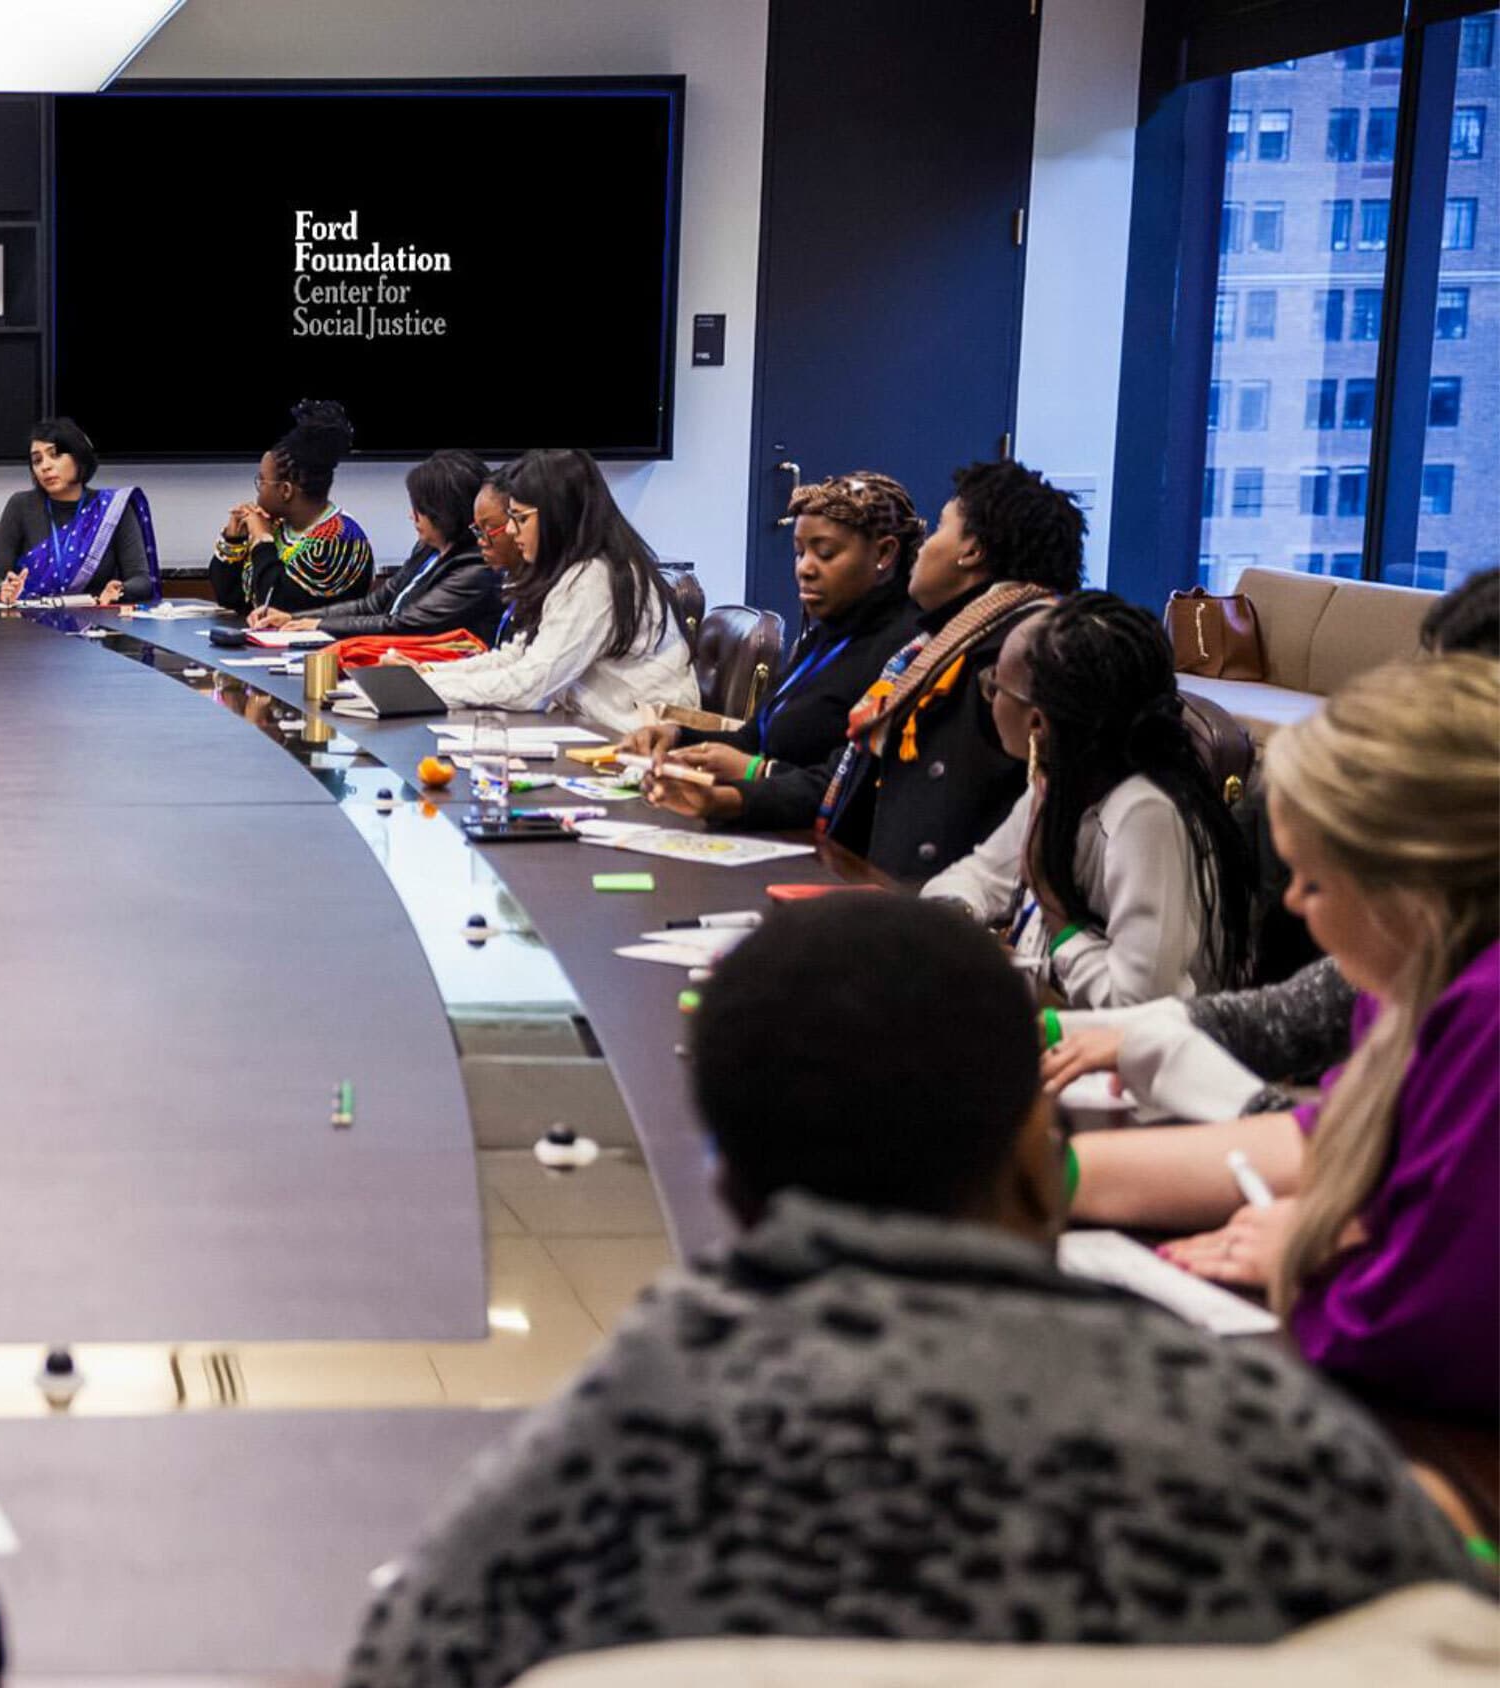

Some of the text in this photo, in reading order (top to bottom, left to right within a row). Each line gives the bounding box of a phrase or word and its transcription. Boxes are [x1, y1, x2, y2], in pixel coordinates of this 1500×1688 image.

[295, 210, 358, 240] Ford
[294, 241, 452, 272] Foundation
[293, 273, 411, 304] Center for
[293, 306, 447, 340] Social Justice
